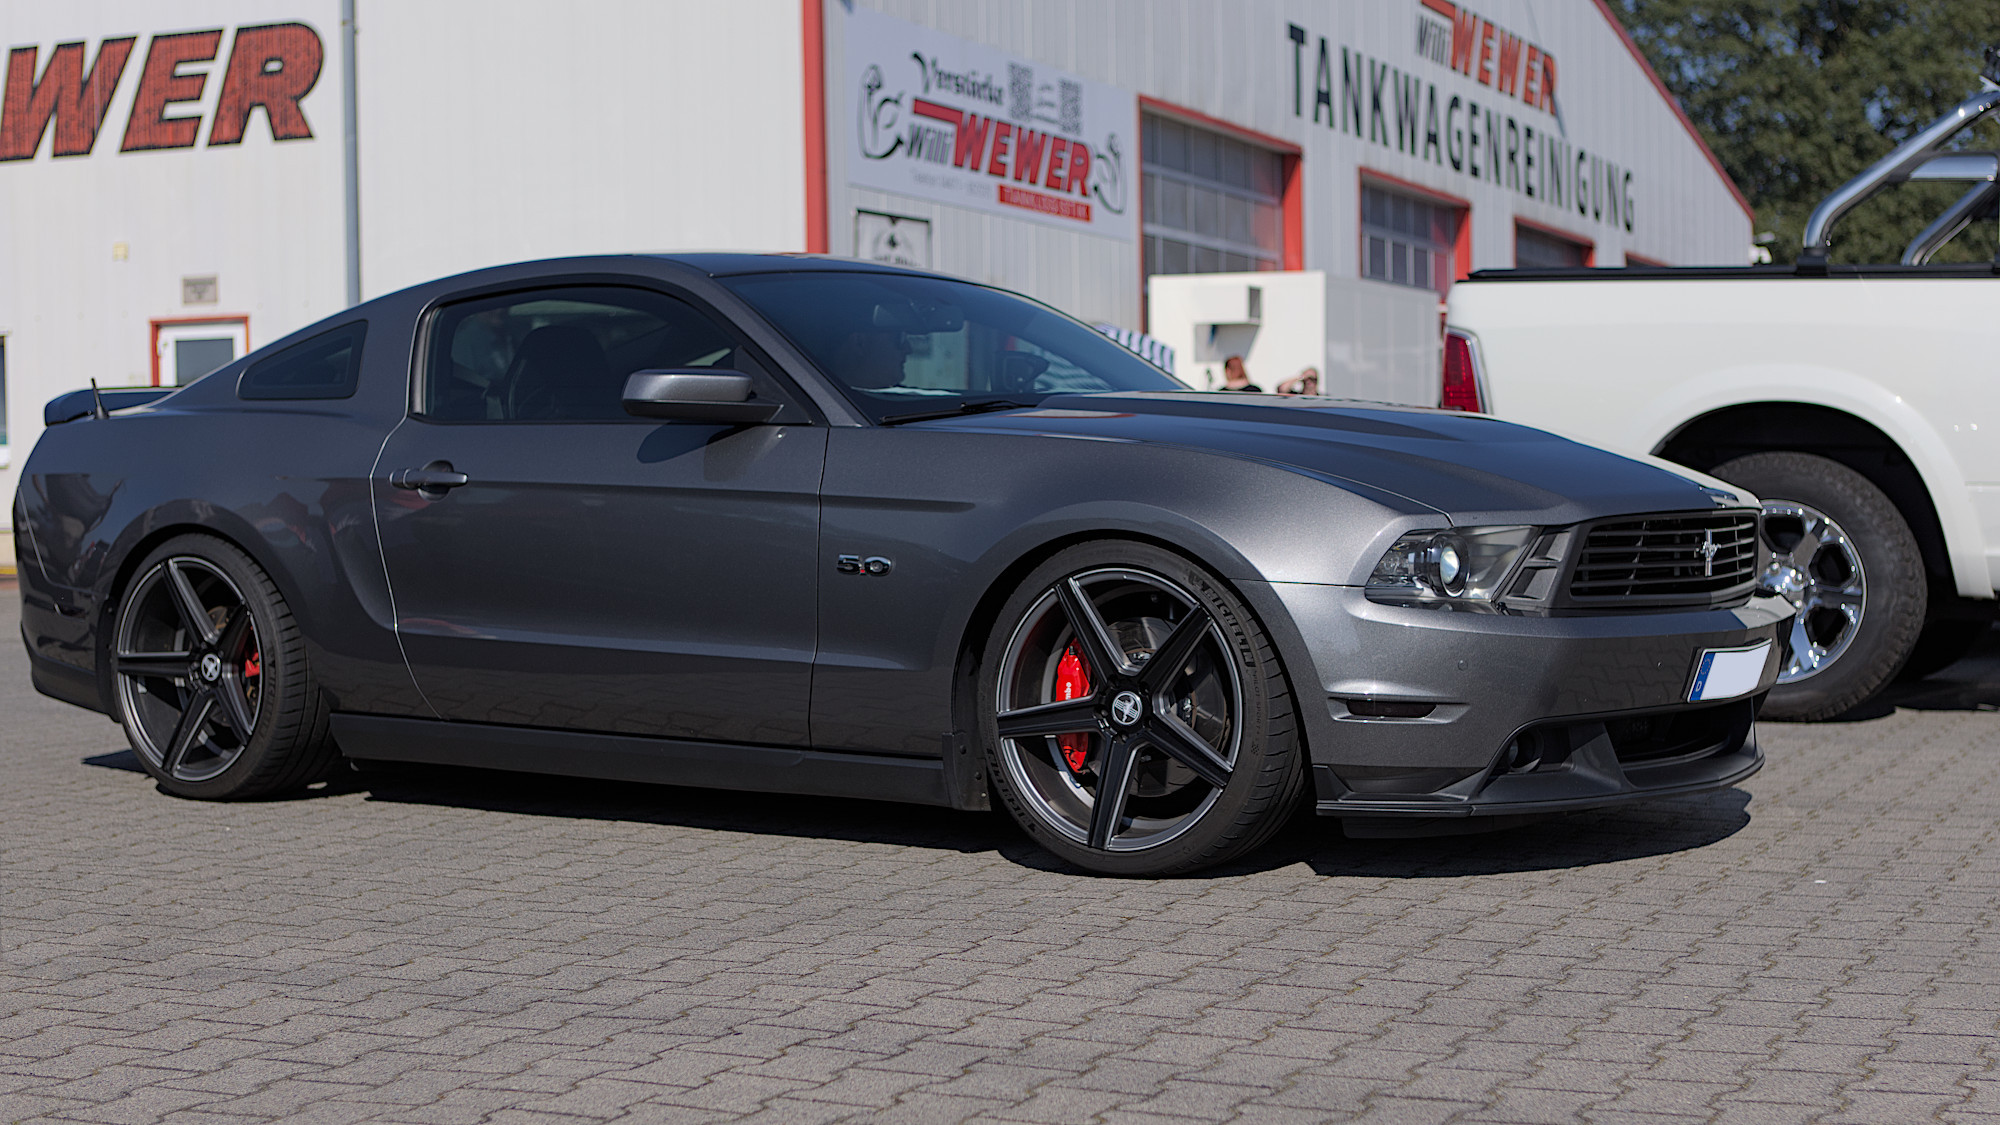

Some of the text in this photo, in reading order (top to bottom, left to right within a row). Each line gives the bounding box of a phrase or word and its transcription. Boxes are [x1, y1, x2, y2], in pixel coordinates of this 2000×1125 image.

[1451, 3, 1557, 117] WEWER
[953, 110, 1091, 198] WEWER
[1288, 22, 1635, 234] TANKWAGENREINIGUNG
[837, 554, 893, 577] 5.0
[1203, 583, 1256, 668] MICHELIN
[1695, 680, 1703, 692] D
